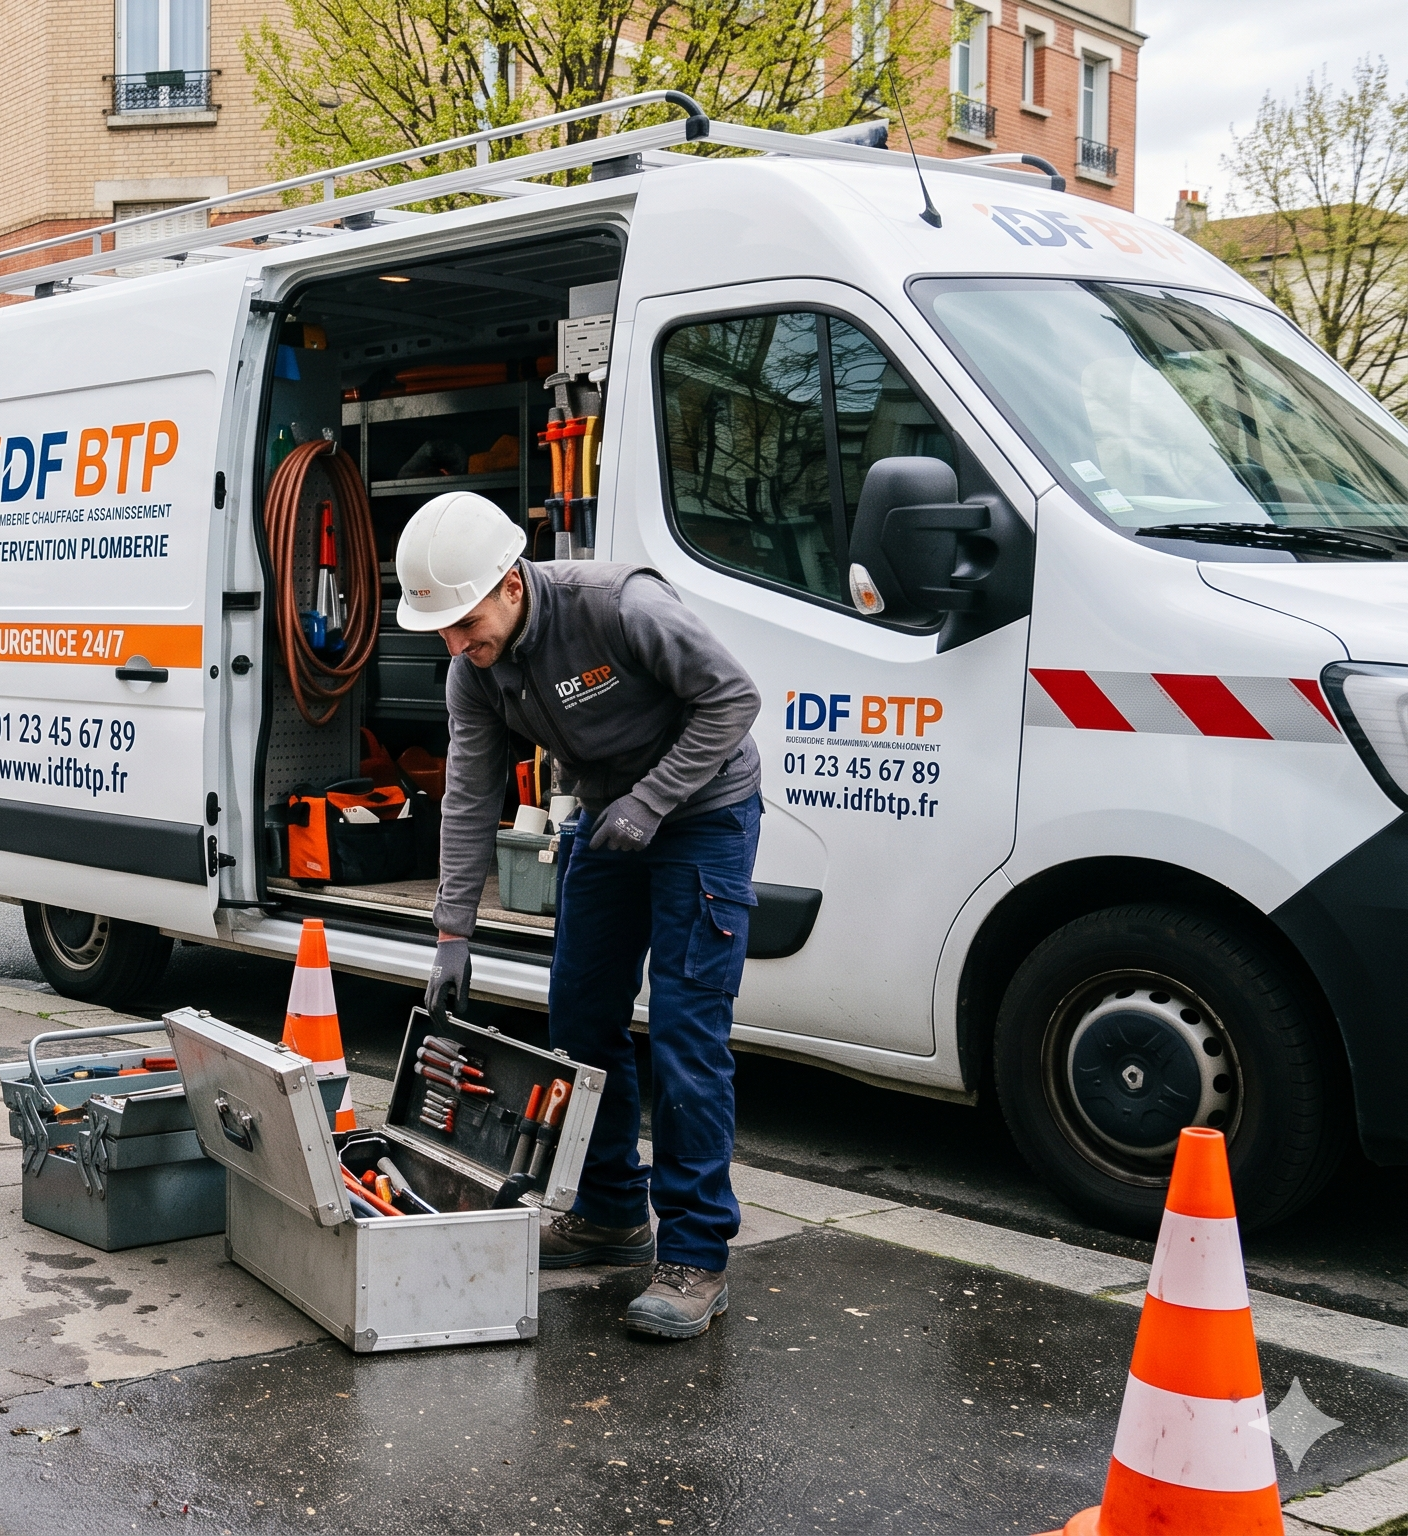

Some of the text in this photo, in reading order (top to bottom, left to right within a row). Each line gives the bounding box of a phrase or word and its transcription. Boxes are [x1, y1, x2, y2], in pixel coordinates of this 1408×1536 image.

[1076, 213, 1188, 265] BTP
[74, 419, 179, 497] BTP
[32, 508, 85, 525] CHAUFFAGE
[87, 503, 172, 521] ASSAINISSEMENT
[81, 534, 169, 560] PLOMBERIE
[82, 629, 124, 659] 24/7
[582, 665, 611, 687] BTP
[785, 690, 944, 737] IDF BTP
[19, 713, 42, 744] 23
[48, 716, 71, 746] 45
[79, 718, 104, 748] 67
[110, 719, 135, 752] 89
[783, 752, 940, 784] 01 23 45 67 89
[785, 786, 939, 820] www.idfbtp.fr
